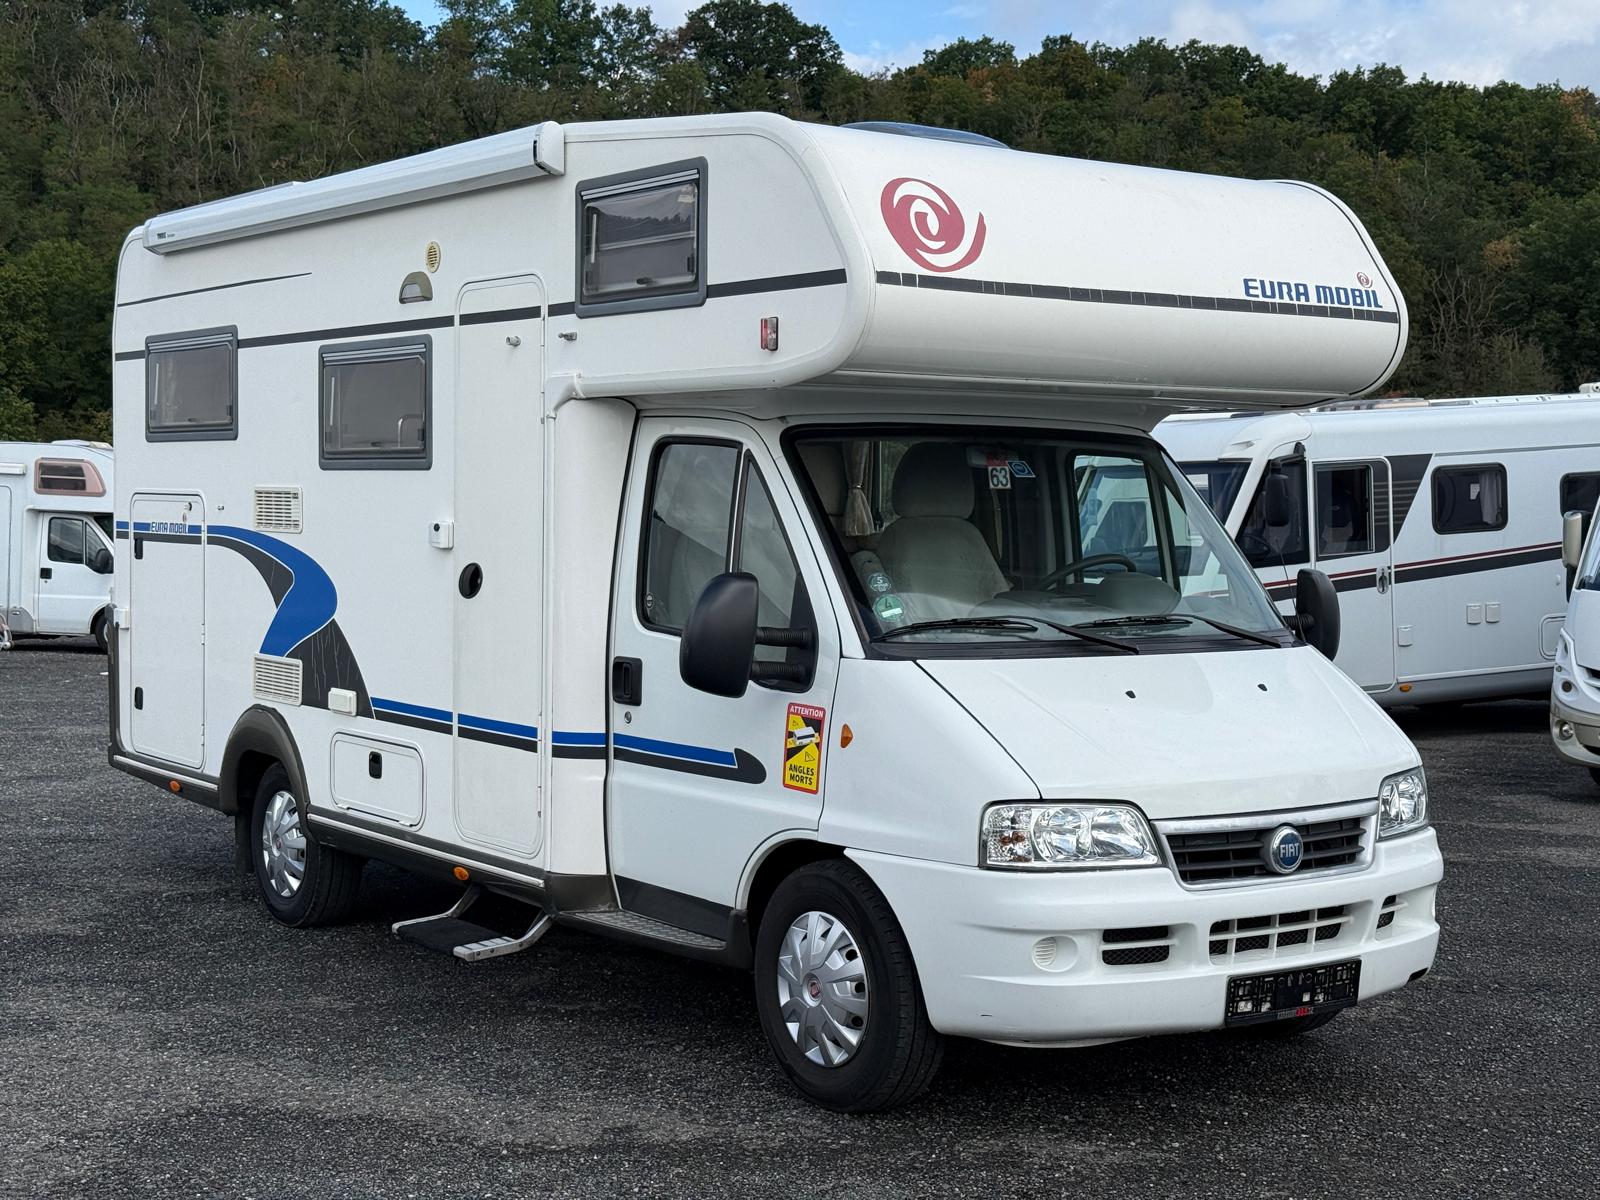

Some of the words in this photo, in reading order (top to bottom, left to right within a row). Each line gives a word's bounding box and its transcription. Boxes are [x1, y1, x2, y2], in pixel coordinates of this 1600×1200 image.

[1242, 278, 1310, 303] EURA
[1314, 284, 1383, 309] MOBIL
[990, 467, 1009, 488] 63
[150, 521, 168, 533] EURA
[168, 522, 188, 535] MOBIL
[789, 705, 824, 718] ATTENTION
[788, 763, 815, 777] ANGLES
[789, 773, 813, 786] MORTS
[1279, 842, 1300, 858] FIAT
